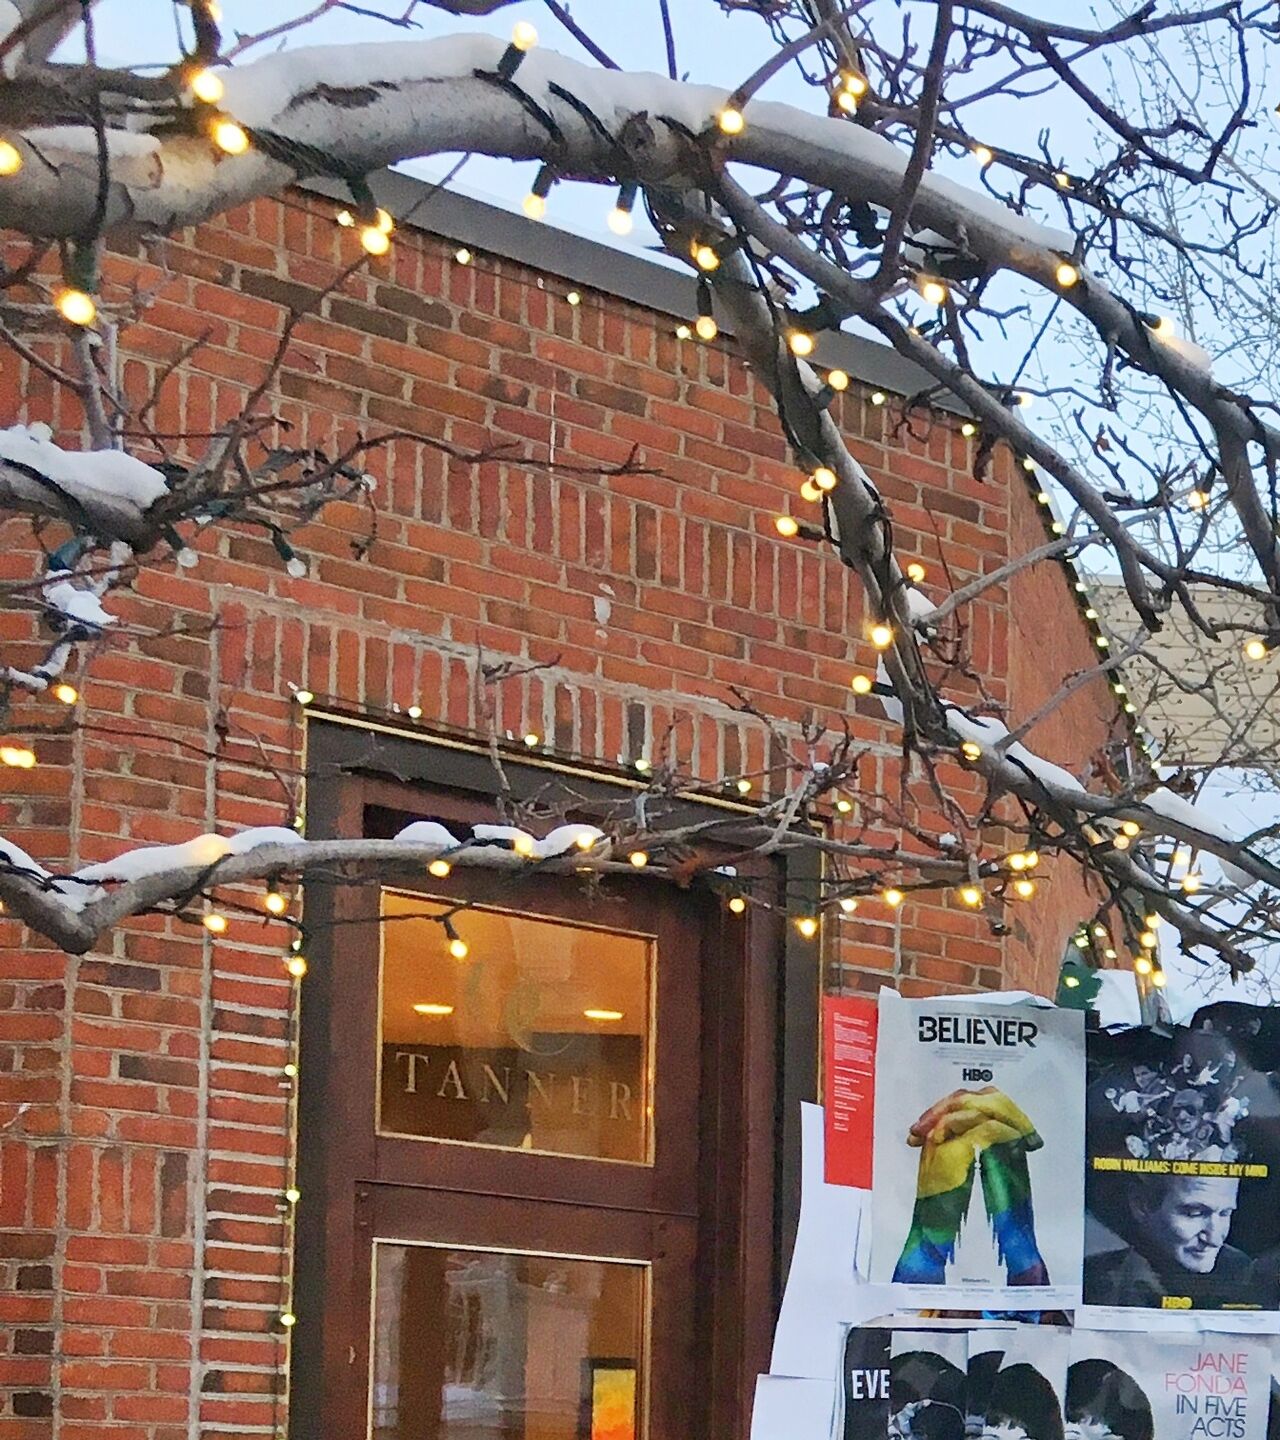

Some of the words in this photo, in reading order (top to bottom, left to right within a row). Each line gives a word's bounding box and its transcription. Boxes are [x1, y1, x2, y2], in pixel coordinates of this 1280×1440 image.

[918, 1015, 1038, 1049] BELIEVER
[962, 1068, 993, 1082] HBO
[394, 1052, 633, 1121] TANNER
[1172, 1161, 1198, 1174] COME
[1199, 1163, 1227, 1176] INSIDE
[1229, 1164, 1244, 1176] MY
[1245, 1164, 1269, 1178] MIND
[1190, 1353, 1248, 1374] JANE
[852, 1369, 890, 1400] EVE
[1165, 1373, 1248, 1395] FONDA
[1176, 1394, 1198, 1415] IN
[1205, 1395, 1248, 1417] FIVE
[1190, 1417, 1246, 1438] ACTS
